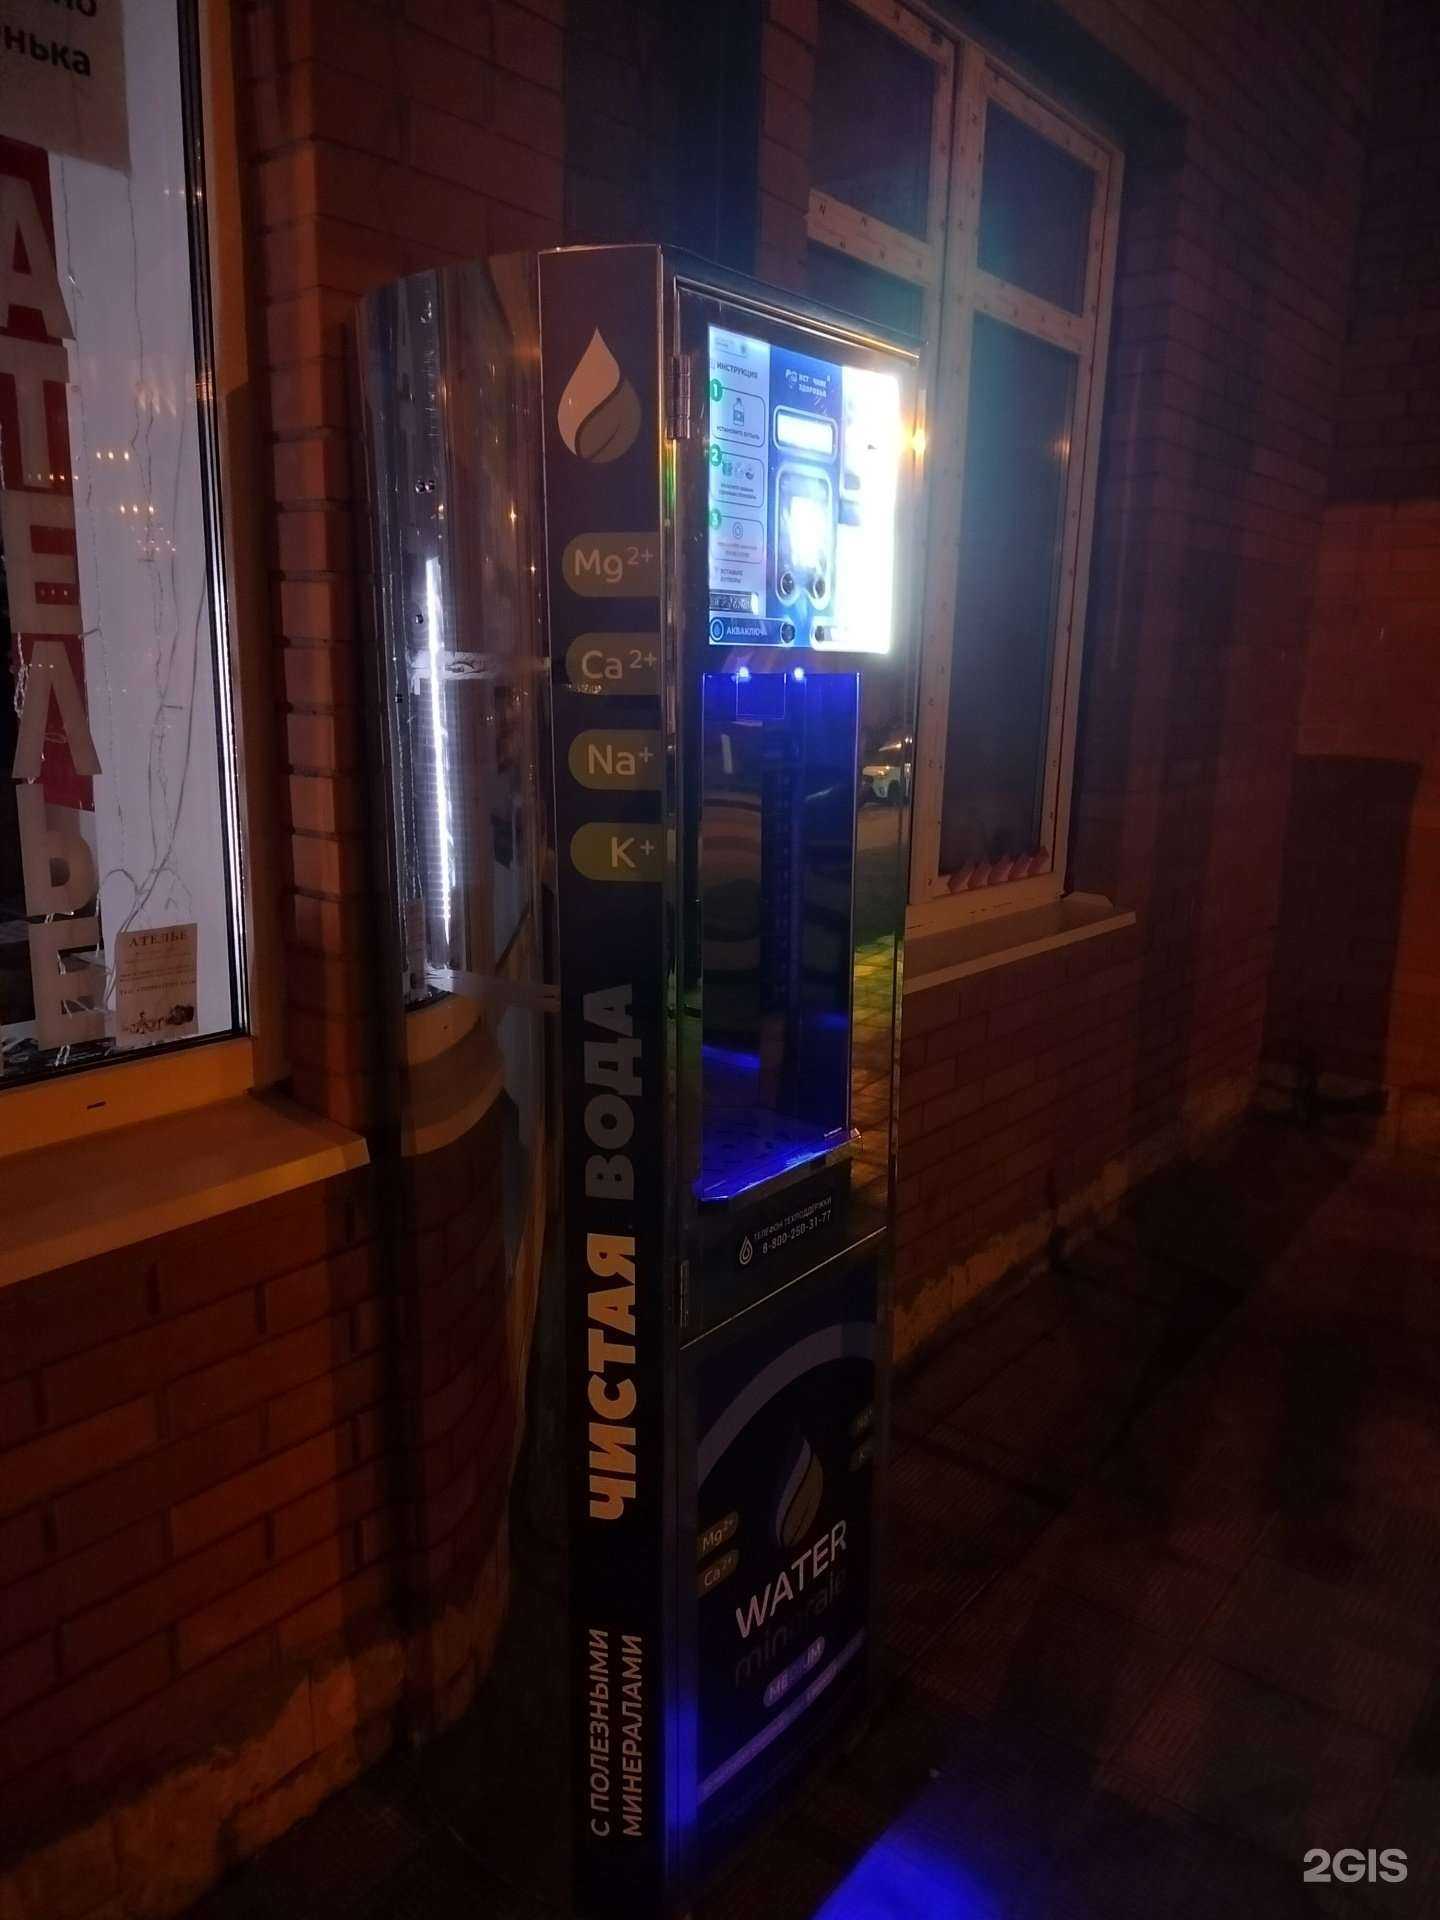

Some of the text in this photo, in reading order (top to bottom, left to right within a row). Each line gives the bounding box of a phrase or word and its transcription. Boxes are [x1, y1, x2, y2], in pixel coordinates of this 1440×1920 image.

[582, 983, 643, 1520] ЧИСТАЯ ВОДА
[735, 1519, 848, 1640] WATER
[588, 1627, 611, 1812] ПОЛЕЗНЫМИ
[620, 1634, 643, 1837] МИНЕРАЛАМИ
